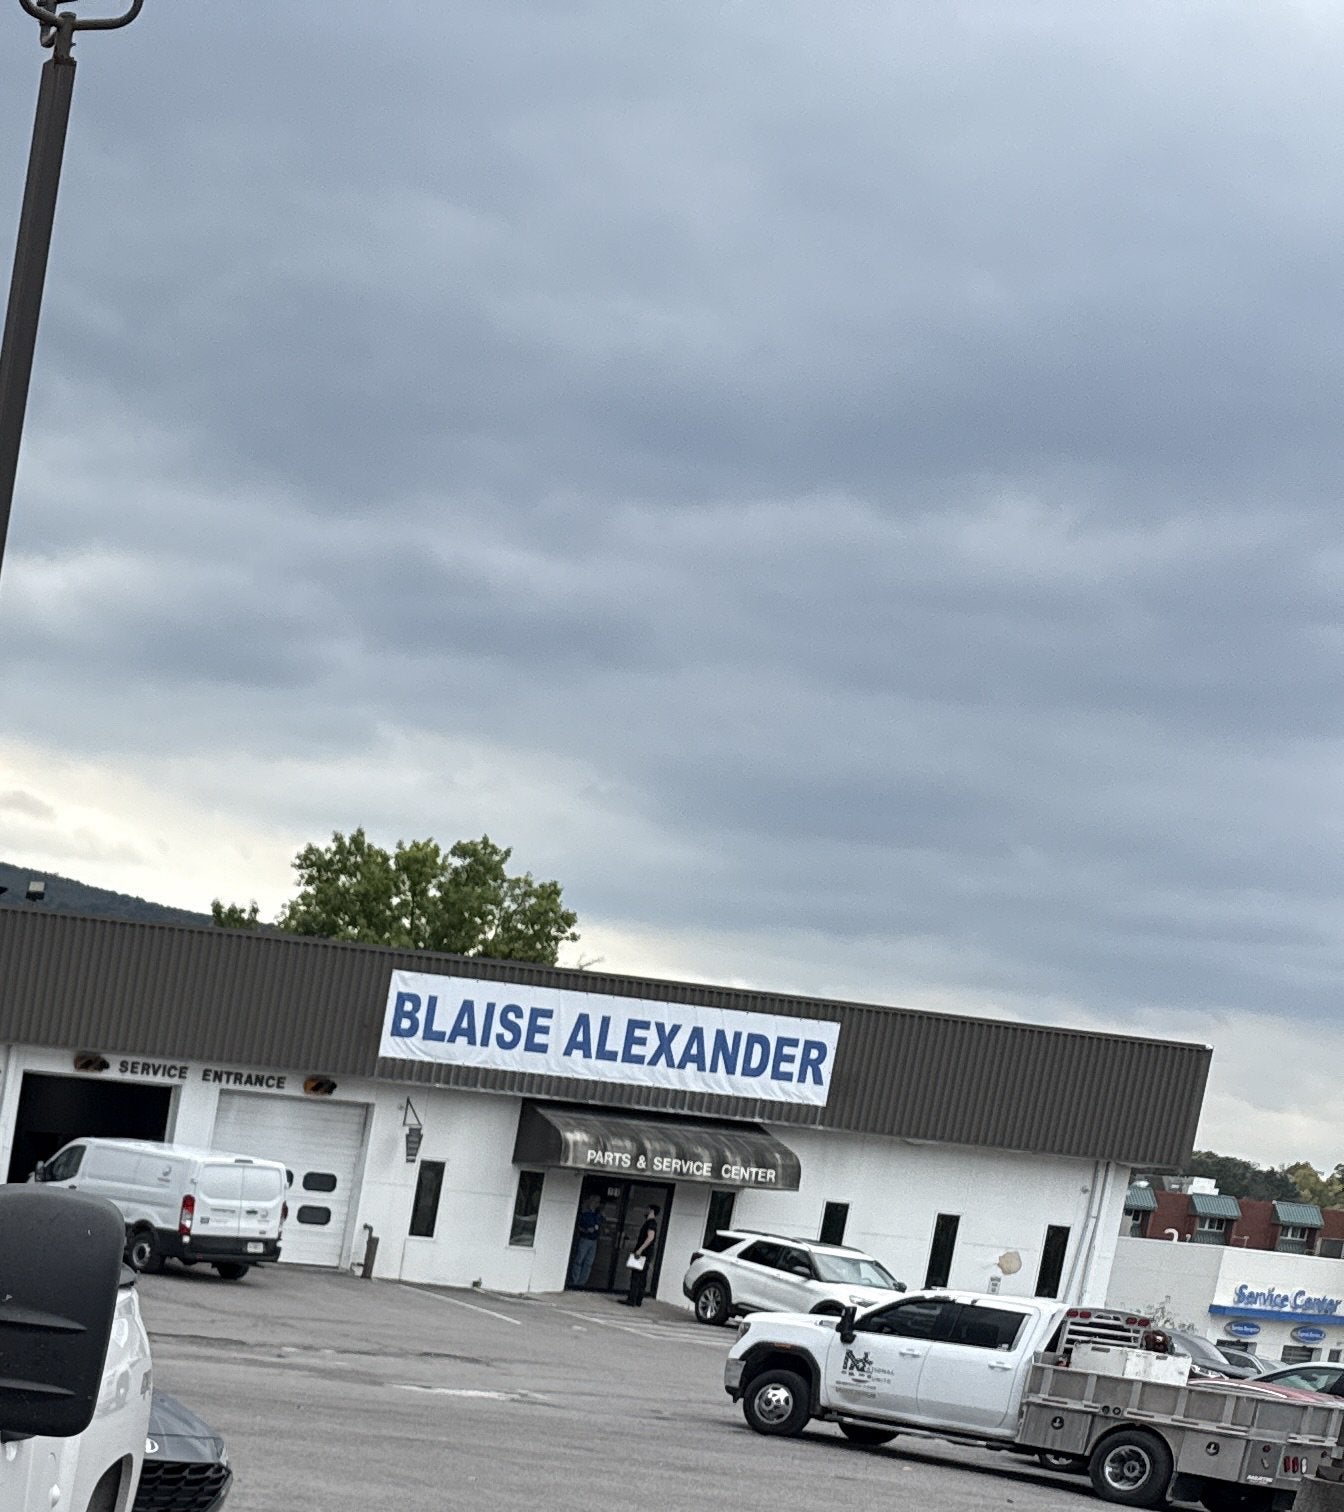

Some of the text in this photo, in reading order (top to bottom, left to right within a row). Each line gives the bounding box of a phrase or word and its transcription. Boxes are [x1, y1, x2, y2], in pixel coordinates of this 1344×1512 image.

[391, 992, 828, 1086] BLAISE ALEXANDER
[118, 1060, 286, 1089] SERVICE ENTRANCE
[587, 1150, 776, 1183] PARTS & SERVICE CENTER
[1234, 1284, 1342, 1314] Service Center
